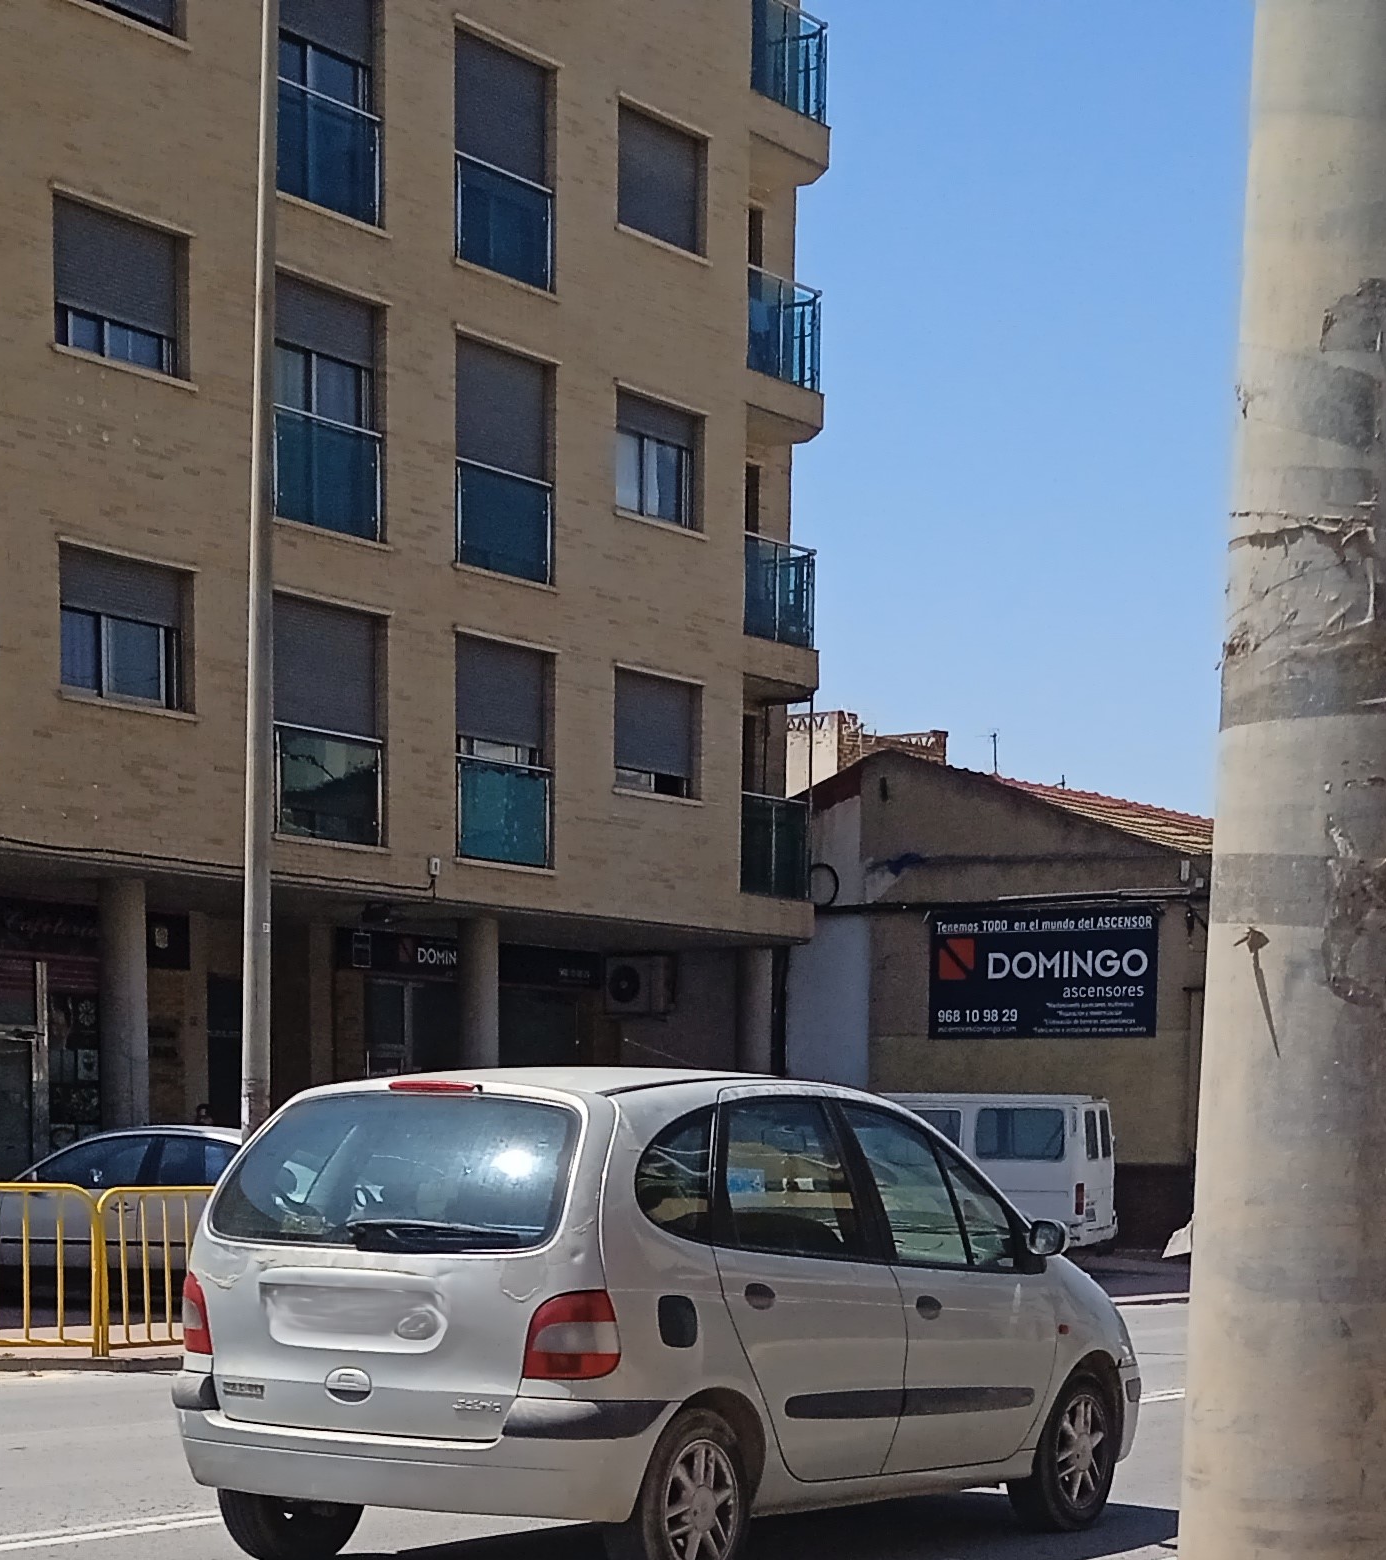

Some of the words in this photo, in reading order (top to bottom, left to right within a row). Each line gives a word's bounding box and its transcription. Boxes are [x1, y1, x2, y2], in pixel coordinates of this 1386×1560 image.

[936, 921, 979, 933] Tenemos
[983, 919, 1008, 932] TODO
[1014, 920, 1026, 931] en
[1029, 919, 1039, 931] el
[1042, 918, 1075, 931] mundo
[1078, 916, 1094, 929] del
[1097, 915, 1152, 928] ASCENSOR
[417, 947, 457, 965] DOMIN
[987, 948, 1149, 980] DOMINGO
[1062, 984, 1145, 998] ascensores
[938, 1009, 961, 1023] 968
[965, 1009, 980, 1022] 10
[983, 1009, 999, 1022] 98
[1001, 1008, 1018, 1022] 29
